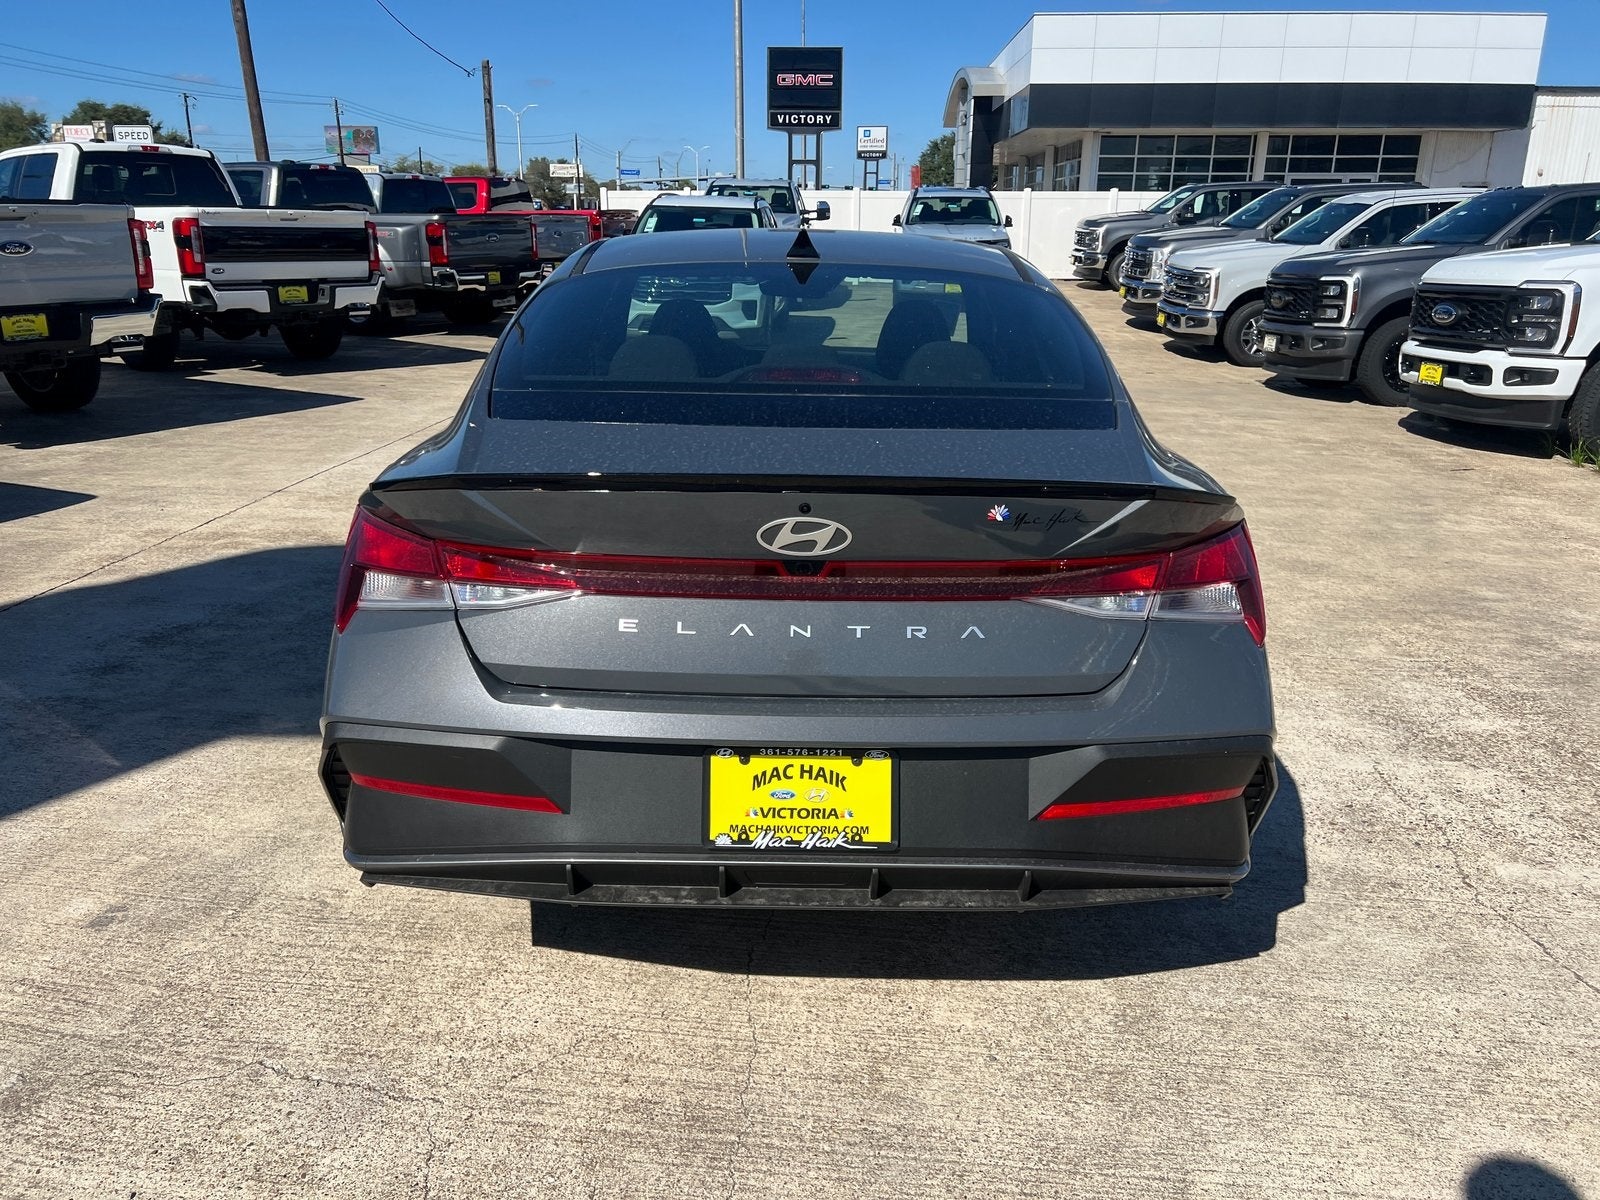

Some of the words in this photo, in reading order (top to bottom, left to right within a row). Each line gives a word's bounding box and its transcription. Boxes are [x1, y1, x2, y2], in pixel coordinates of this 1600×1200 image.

[777, 74, 833, 86] GMC
[777, 114, 832, 124] VICTORY
[117, 131, 149, 140] SPEED
[618, 618, 986, 639] ELANTRA
[759, 748, 843, 757] 361-576-1221
[752, 763, 794, 791] MAC
[800, 764, 847, 792] HAIK
[759, 807, 839, 820] VICTORIA
[751, 830, 799, 850] Mac
[800, 830, 852, 850] Haik
